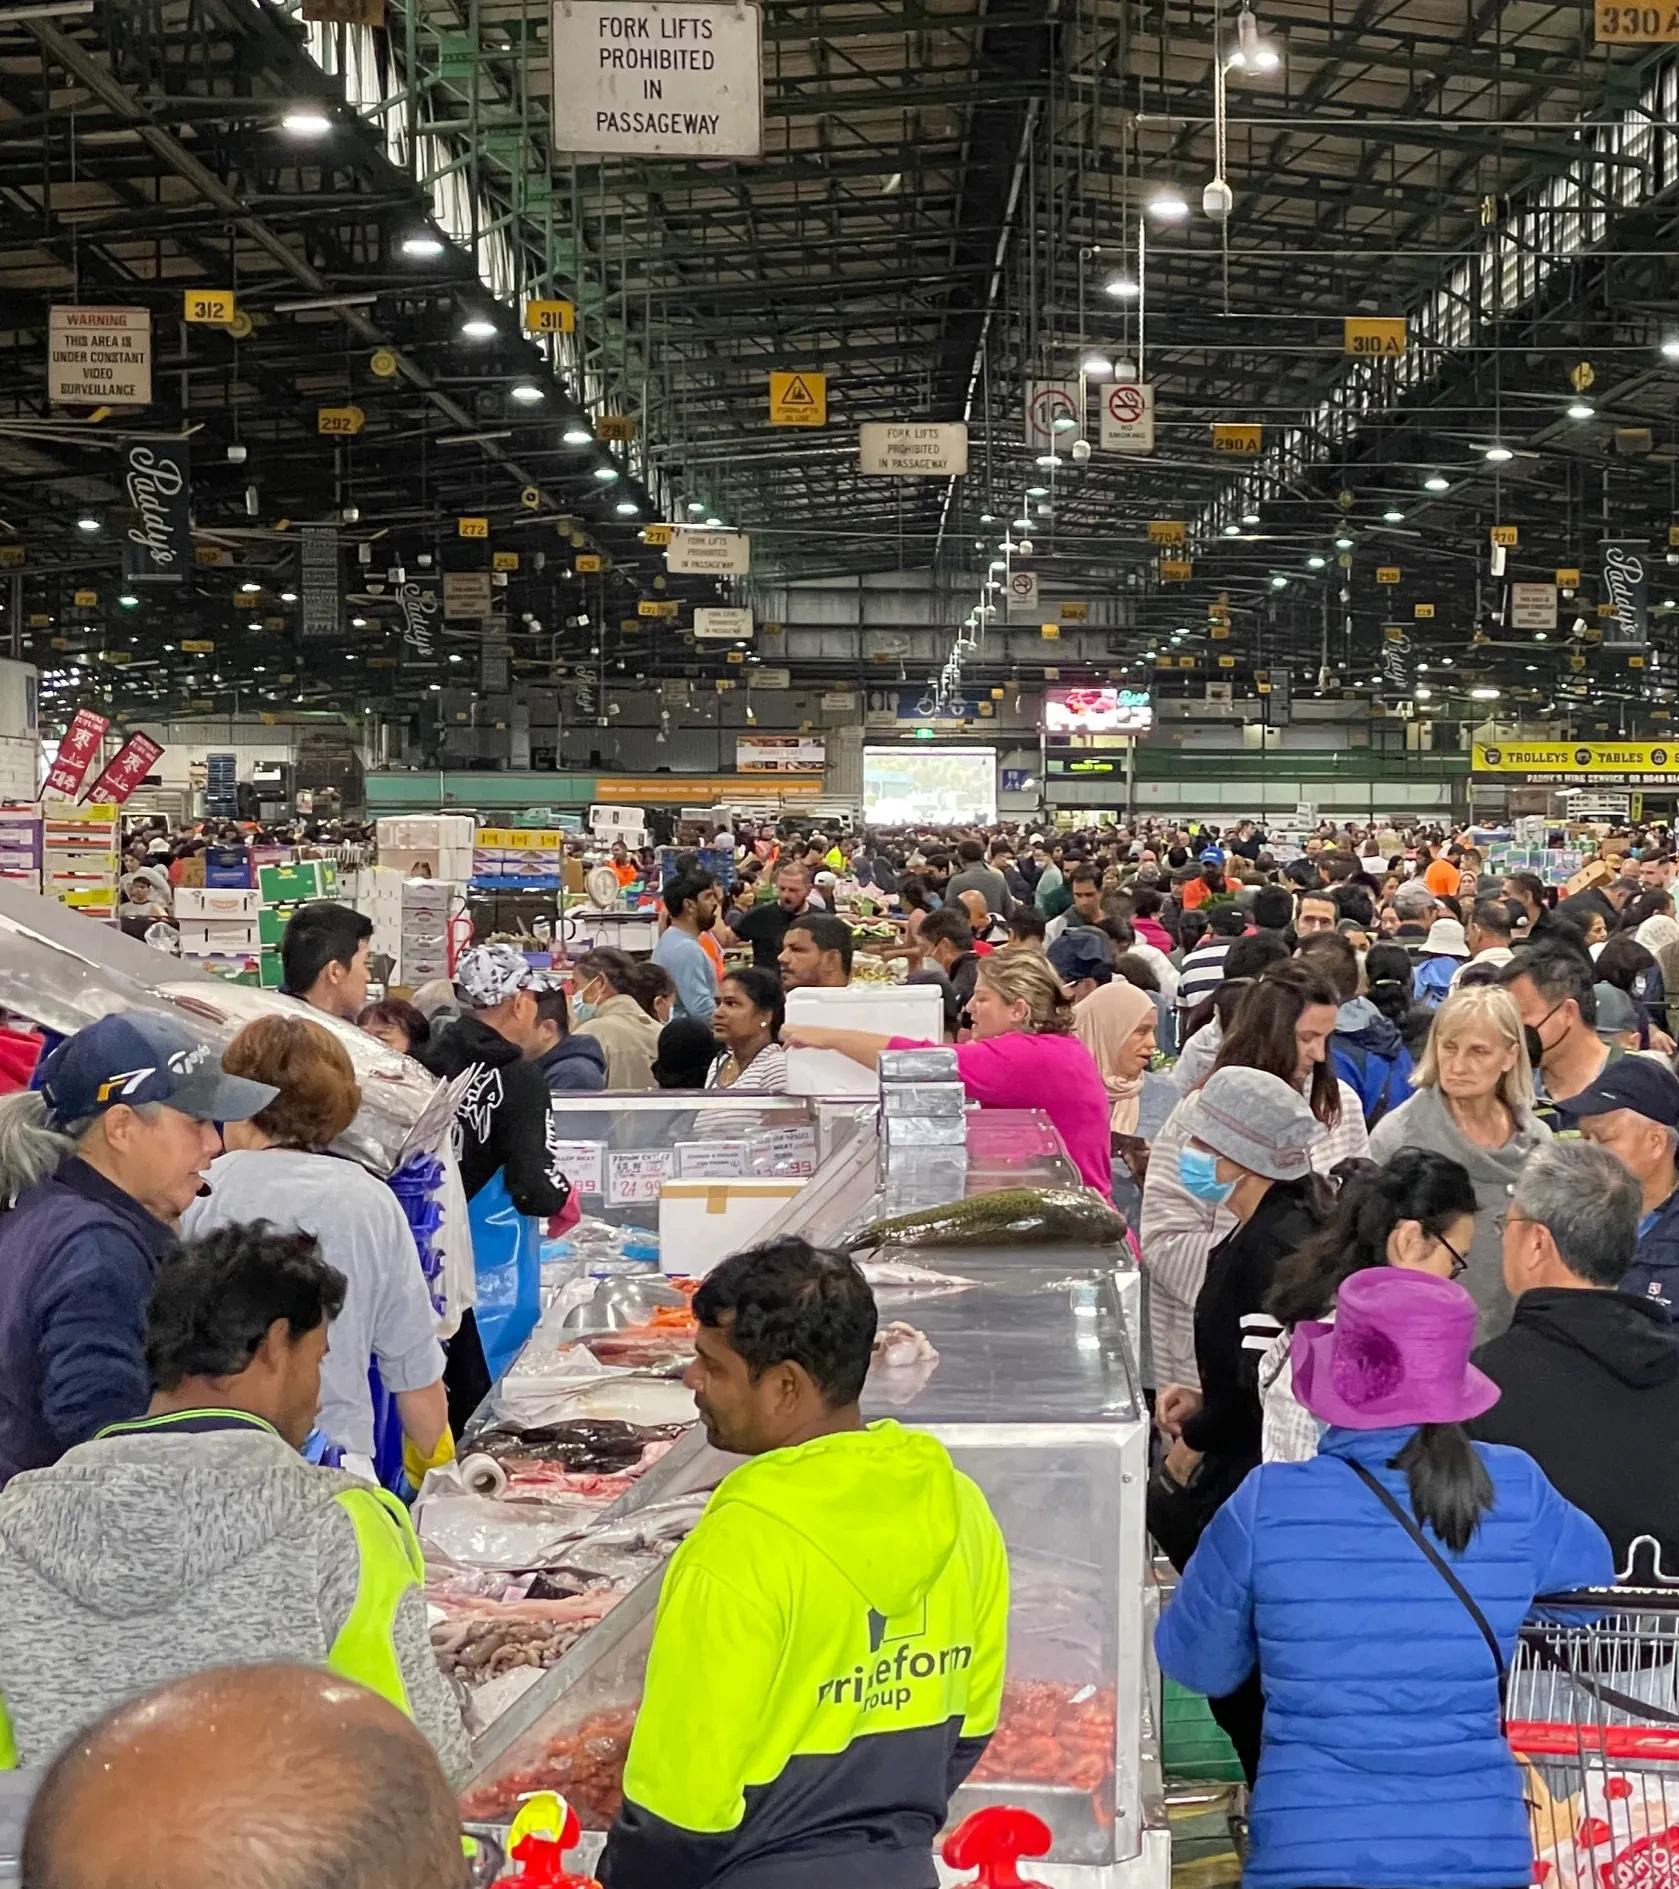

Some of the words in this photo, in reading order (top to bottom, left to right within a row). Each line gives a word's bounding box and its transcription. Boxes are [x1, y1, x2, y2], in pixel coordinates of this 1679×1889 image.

[600, 17, 649, 38] FORK
[661, 19, 712, 39] LIFTS
[1602, 8, 1660, 35] 330
[600, 48, 715, 70] PROHIBITED
[644, 79, 662, 99] IN
[597, 112, 719, 134] PASSAGEWAY
[195, 302, 224, 318] 312
[67, 314, 127, 326] WARNING
[540, 312, 563, 329] 311
[65, 336, 88, 347] THIS
[91, 336, 119, 348] AREA
[122, 336, 132, 347] IS
[1353, 336, 1382, 354] 310
[1385, 336, 1399, 354] A
[53, 351, 87, 363] UNDER
[90, 352, 144, 364] CONSTANT
[83, 368, 113, 379] VIDEO
[61, 383, 136, 395] SURVEILLANCE
[322, 417, 351, 431] 292
[888, 429, 910, 439] FORK
[915, 429, 939, 439] LIFTS
[888, 444, 940, 454] PROHIBITED
[1216, 439, 1244, 452] 290
[1245, 439, 1258, 452] A
[879, 459, 889, 468] IN
[892, 459, 948, 469] PASSAGEWAY
[127, 447, 182, 566] Paddy's
[462, 523, 484, 534] 272
[647, 530, 666, 540] 271
[1151, 531, 1171, 543] 270
[1172, 531, 1182, 543] A
[1494, 532, 1515, 542] 270
[1507, 752, 1568, 763] TROLLEYS
[1600, 752, 1644, 763] TABLES
[817, 1643, 972, 1708] rieform
[864, 1687, 912, 1712] roup
